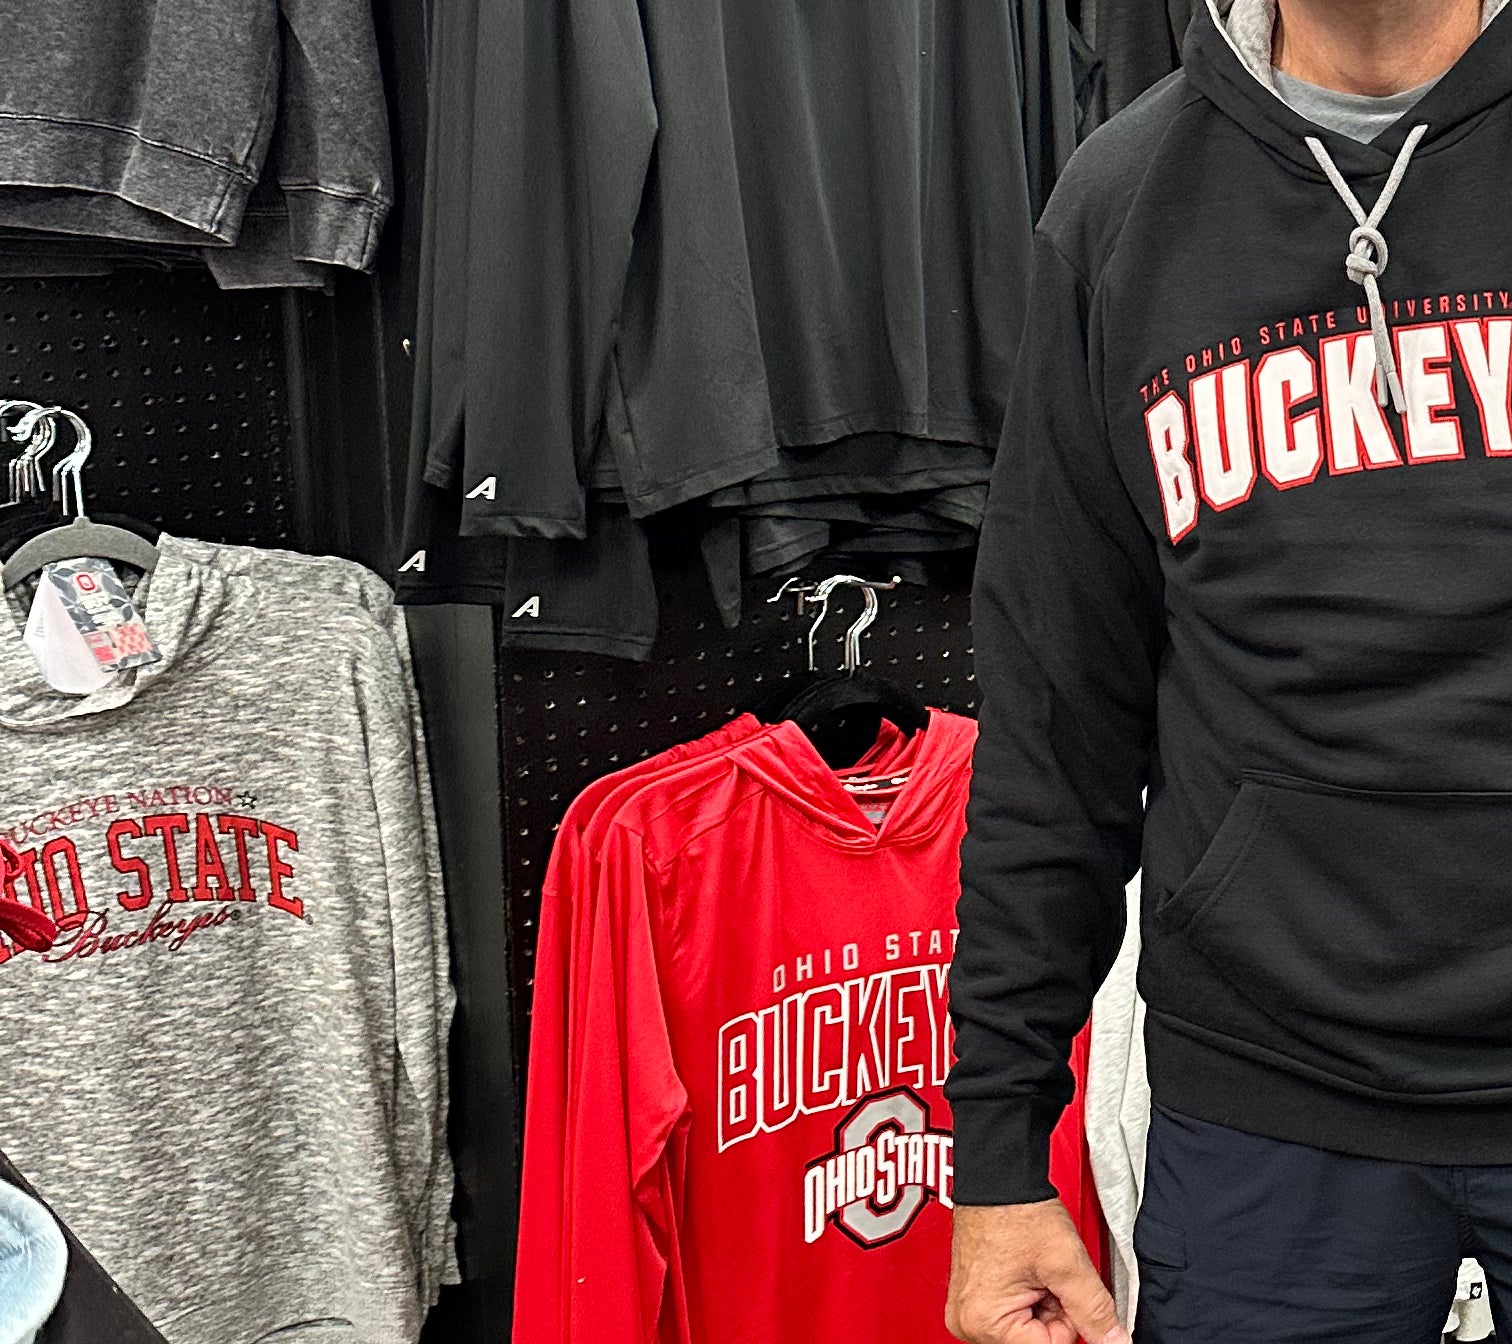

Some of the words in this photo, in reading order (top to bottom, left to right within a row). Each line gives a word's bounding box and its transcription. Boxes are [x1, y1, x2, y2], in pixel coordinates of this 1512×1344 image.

[1140, 368, 1170, 403] THE
[1185, 336, 1244, 375] OHIO
[1258, 310, 1338, 346] STATE
[1356, 289, 1510, 325] UIVERSITY
[126, 785, 234, 808] NATION
[105, 812, 305, 921] STATE
[43, 900, 232, 964] Buckeyes
[772, 942, 860, 994] OHIO
[885, 928, 961, 961] STAT
[717, 962, 956, 1154] BUCKEY
